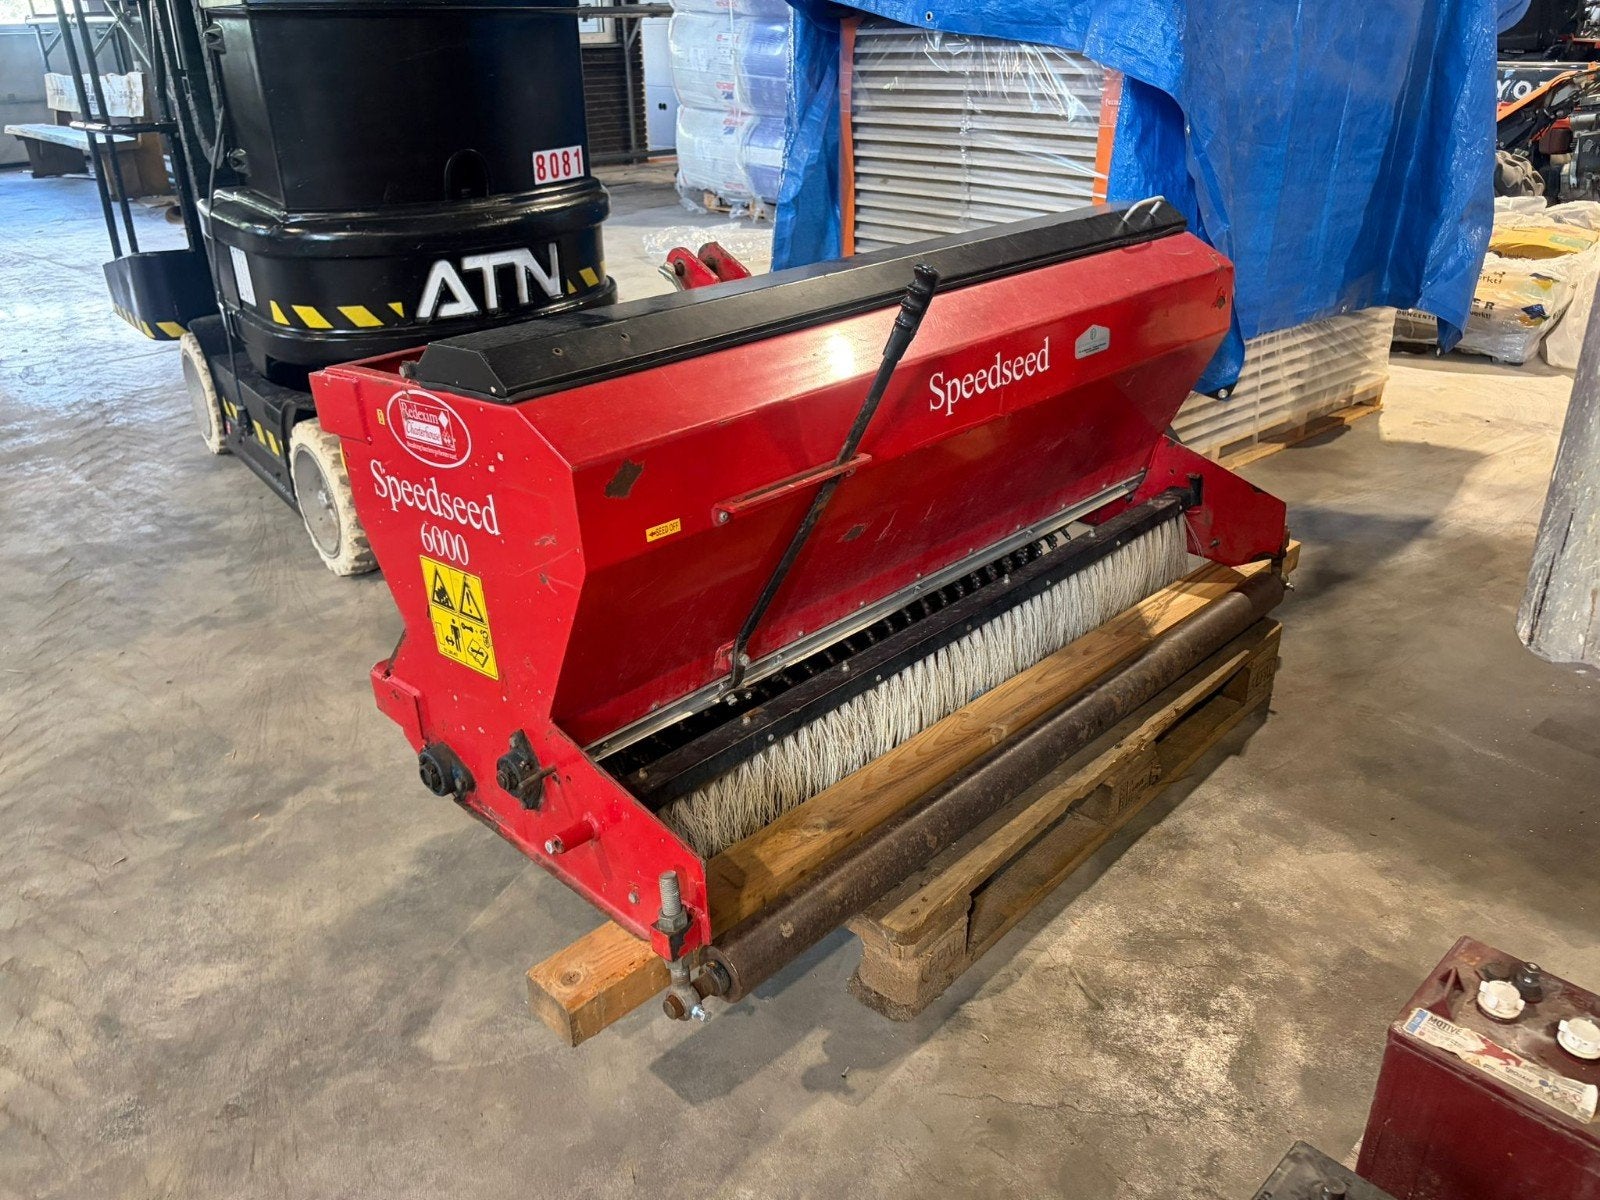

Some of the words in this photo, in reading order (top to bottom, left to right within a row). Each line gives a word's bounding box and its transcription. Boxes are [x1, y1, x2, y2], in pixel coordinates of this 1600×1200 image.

[1497, 79, 1548, 99] YO
[534, 148, 582, 181] 8081
[416, 243, 562, 319] ATN
[928, 336, 1050, 416] Speedseed
[400, 402, 440, 425] Redexim
[370, 459, 501, 536] Speedseed
[420, 521, 469, 566] 6000
